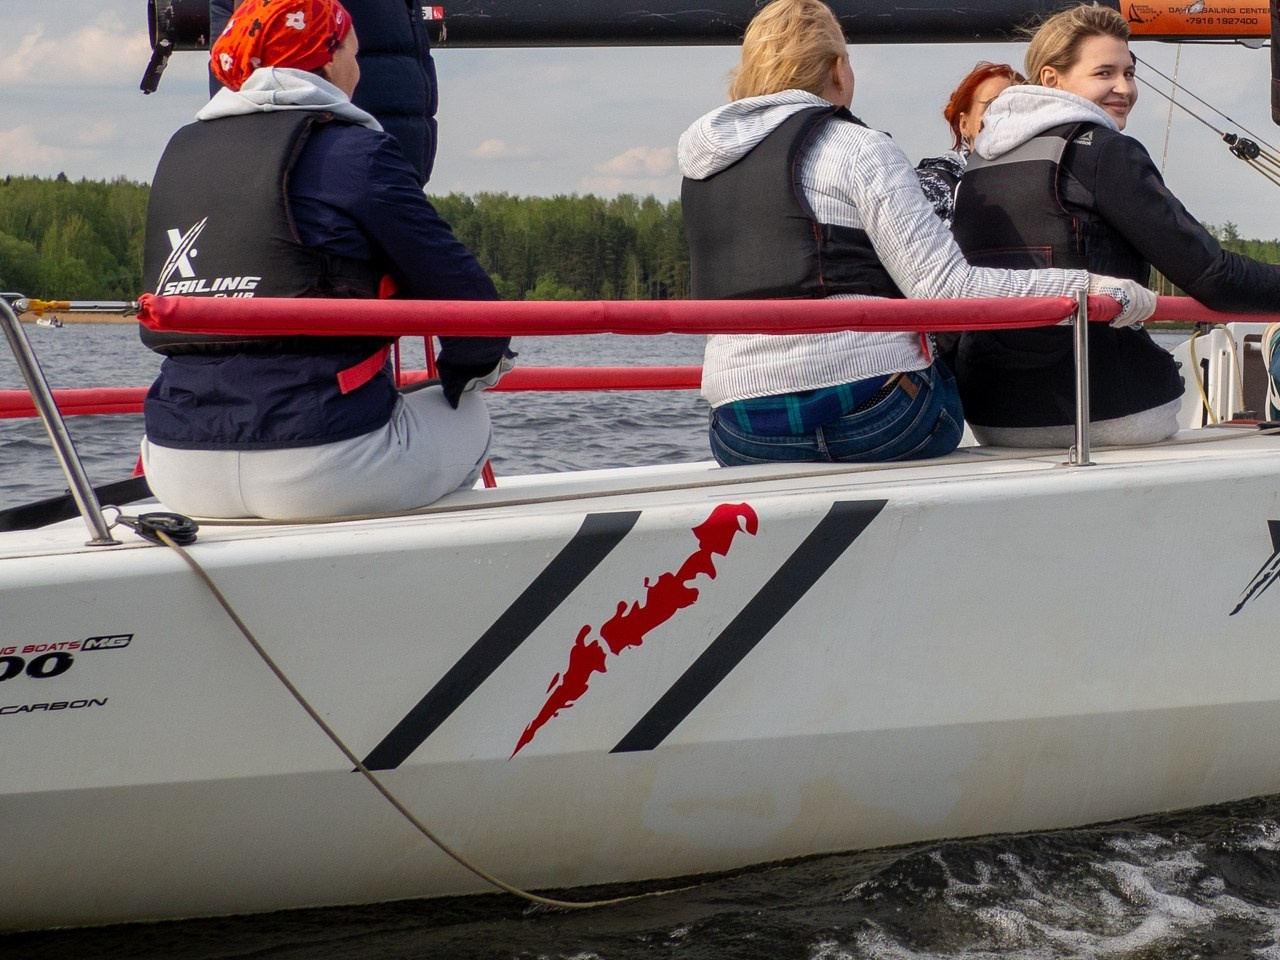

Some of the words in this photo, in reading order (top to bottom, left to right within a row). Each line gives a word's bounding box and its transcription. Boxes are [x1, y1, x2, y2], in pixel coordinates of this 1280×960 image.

[1216, 17, 1259, 25] 1927400
[162, 276, 262, 296] SAILING
[22, 641, 82, 654] BOATS
[82, 634, 134, 651] MG
[0, 697, 109, 715] CARBON
